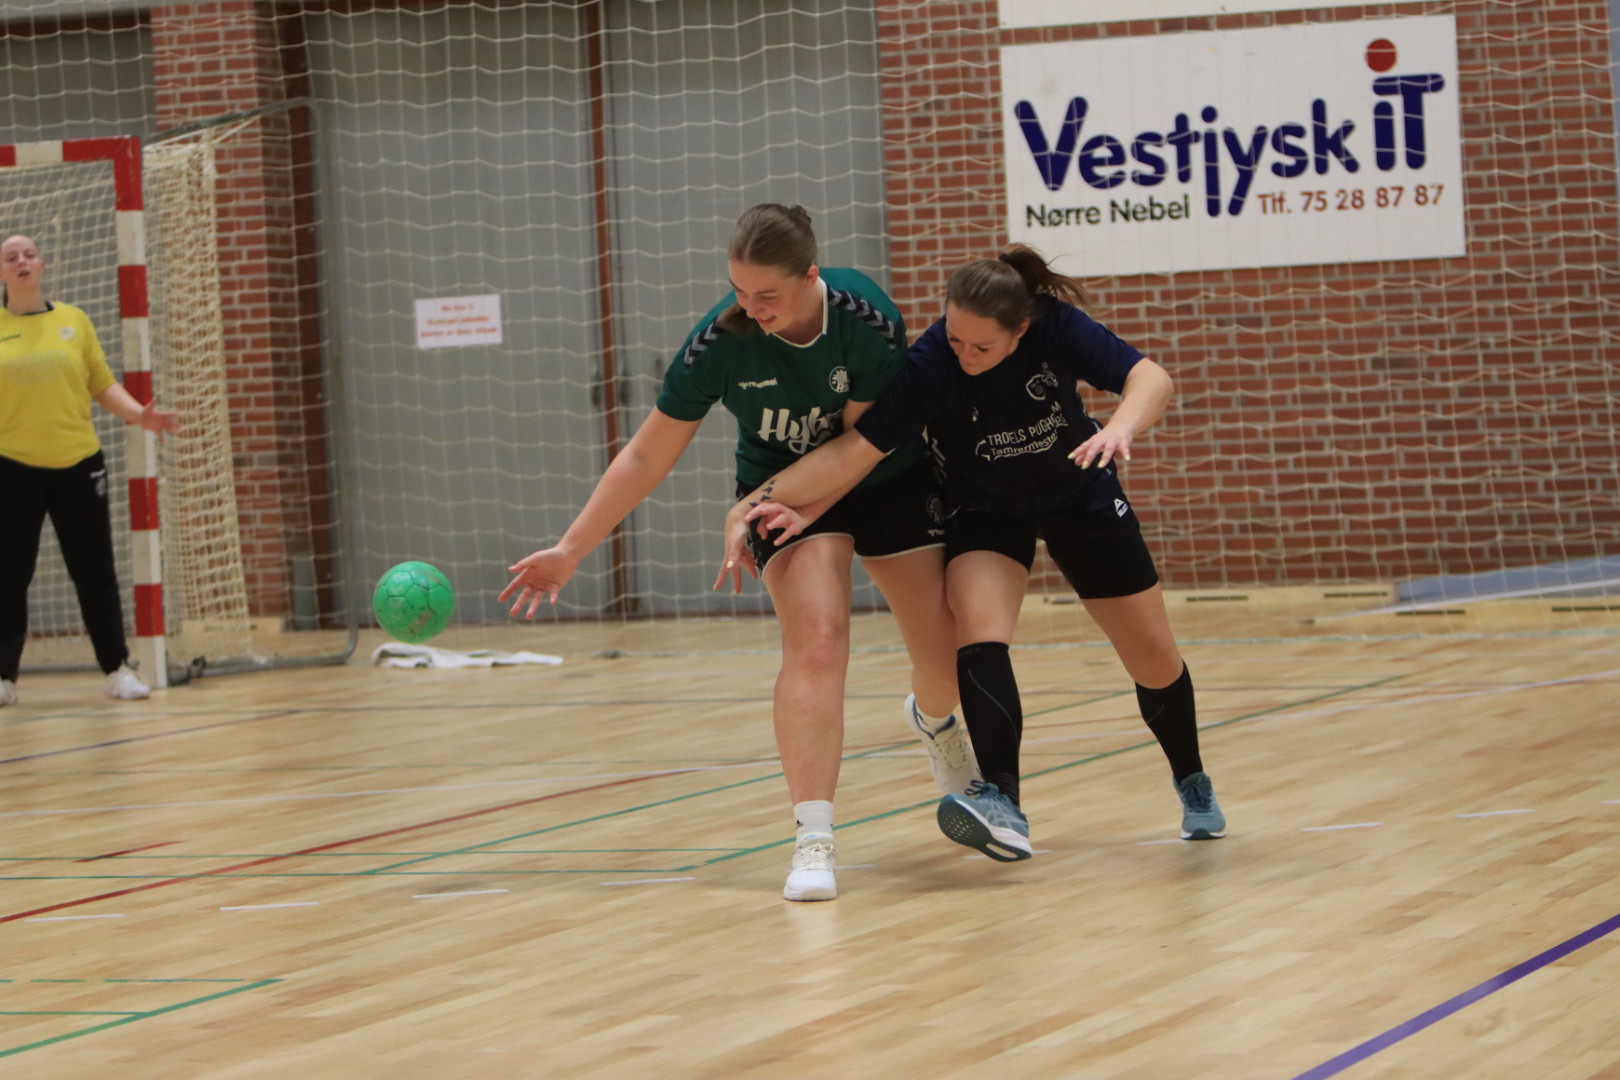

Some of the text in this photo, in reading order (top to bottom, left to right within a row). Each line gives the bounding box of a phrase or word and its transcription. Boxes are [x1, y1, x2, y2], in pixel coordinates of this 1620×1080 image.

[1014, 96, 1360, 217] Vestjysk
[1026, 193, 1190, 228] Nørre Nebel
[1300, 191, 1327, 212] 75
[1335, 189, 1364, 210] 28
[1375, 186, 1404, 208] 87
[1414, 184, 1444, 206] 87
[987, 428, 1027, 447] TROELS
